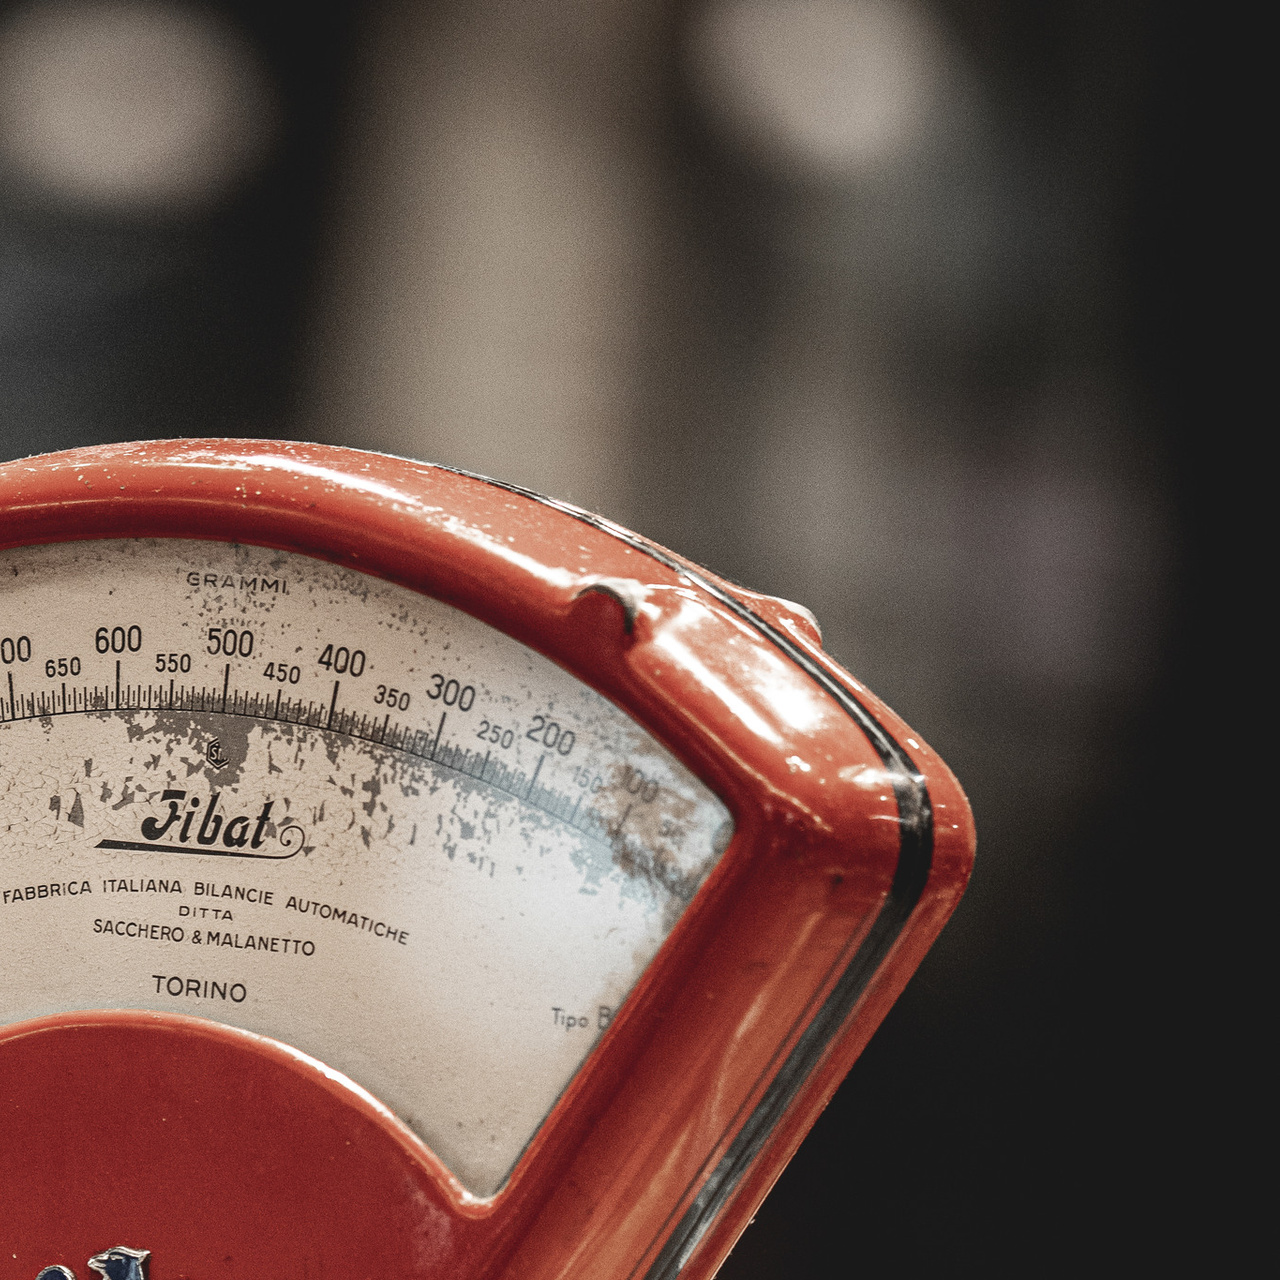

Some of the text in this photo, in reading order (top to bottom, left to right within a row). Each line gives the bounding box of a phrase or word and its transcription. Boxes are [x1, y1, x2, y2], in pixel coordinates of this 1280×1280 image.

[186, 572, 287, 594] GRAMMI
[45, 657, 82, 678] 650
[94, 625, 143, 654] 600
[155, 653, 192, 673] 550
[207, 628, 254, 658] 500
[263, 662, 301, 684] 450
[318, 643, 367, 678] 400
[374, 684, 411, 711] 350
[426, 673, 476, 712] 300
[477, 720, 515, 750] 250
[526, 715, 577, 757] 200
[2, 879, 411, 946] FABBRICA ITALIANA BILANCIE AUTOMATICHE
[178, 905, 234, 922] DITTA
[92, 918, 185, 943] SACCHERO
[152, 974, 247, 1003] TORINO
[552, 1007, 590, 1032] Tipo
